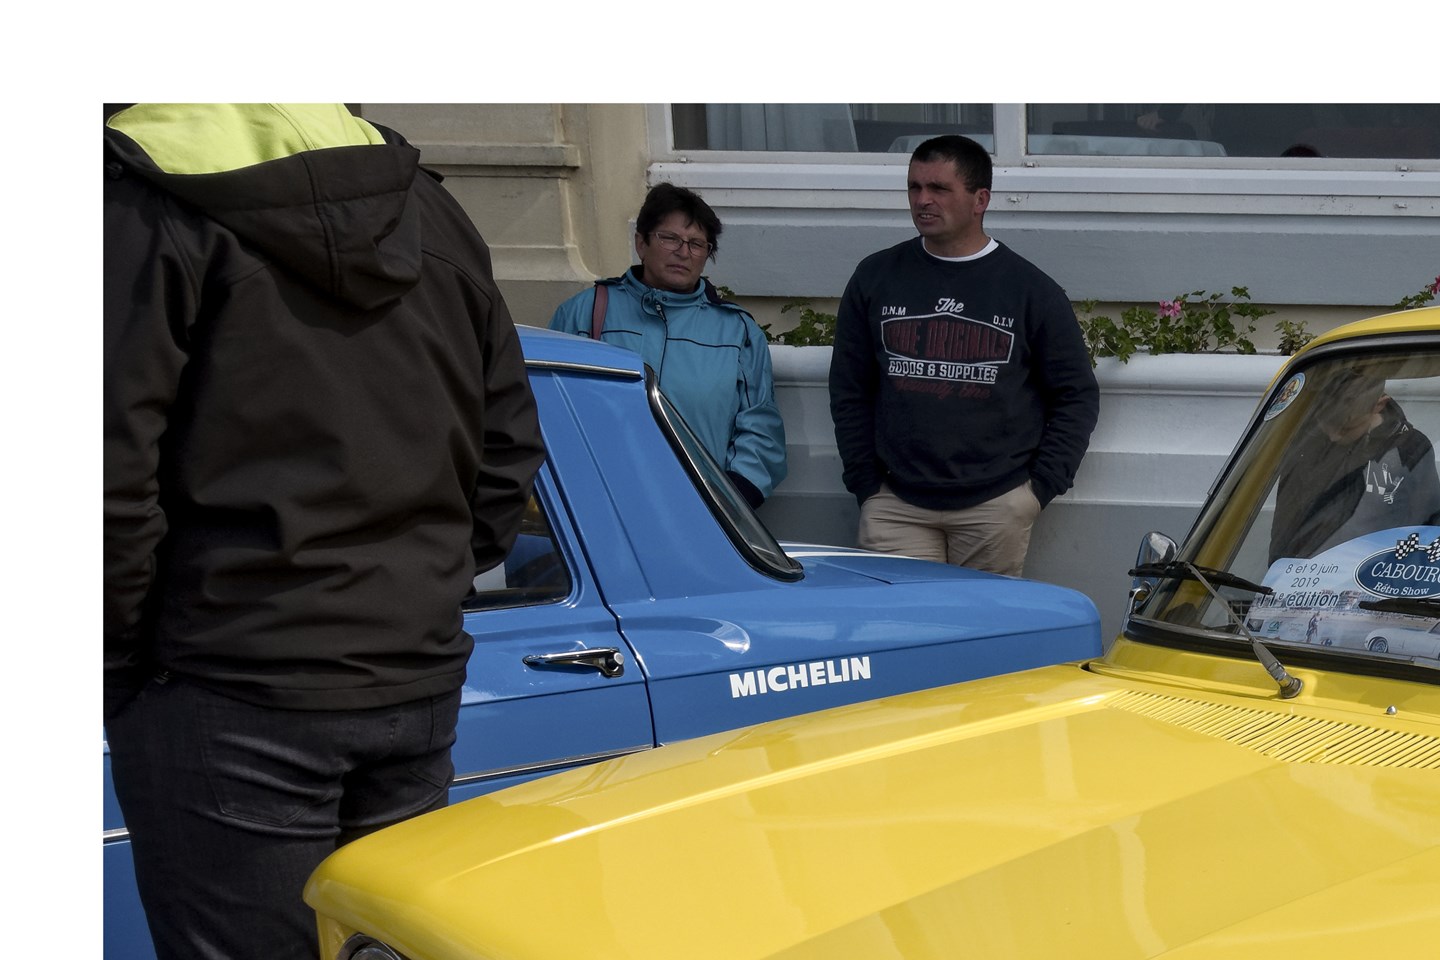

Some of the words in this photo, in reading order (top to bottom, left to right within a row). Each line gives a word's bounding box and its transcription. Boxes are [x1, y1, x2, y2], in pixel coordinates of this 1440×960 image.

[881, 306, 907, 316] D.N.M
[934, 297, 965, 313] The
[992, 315, 1015, 328] D.I.V
[925, 319, 1011, 360] ORIGINALS
[888, 360, 924, 376] GOODS
[927, 364, 936, 377] &
[939, 364, 998, 382] SUPPLIES
[1285, 563, 1293, 574] 8
[1295, 563, 1308, 574] et
[1309, 563, 1318, 574] 9
[1316, 563, 1339, 576] juin
[1290, 577, 1320, 588] 2019
[1373, 581, 1400, 595] Rétro
[1400, 586, 1430, 596] Show
[1286, 591, 1340, 607] édition
[729, 656, 872, 699] MICHELIN
